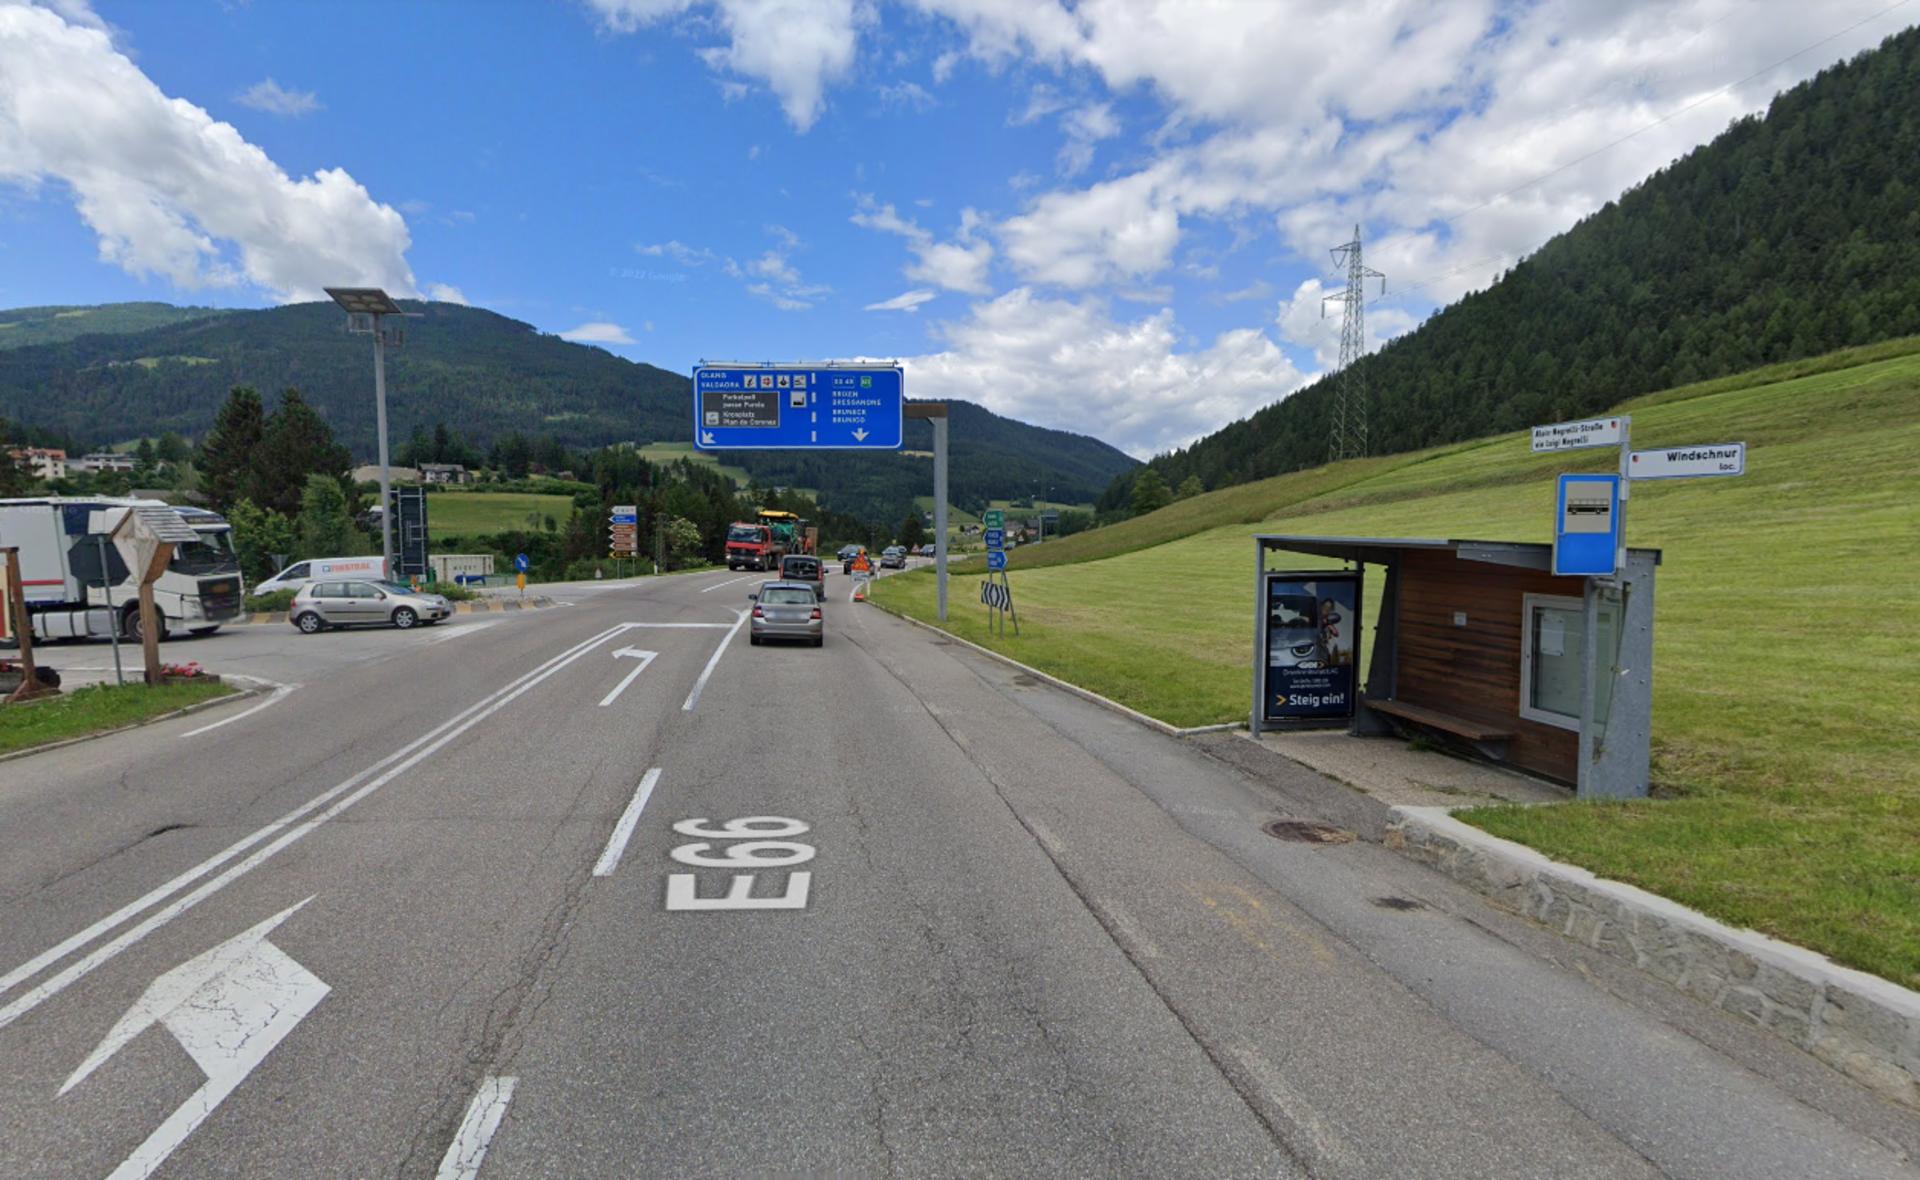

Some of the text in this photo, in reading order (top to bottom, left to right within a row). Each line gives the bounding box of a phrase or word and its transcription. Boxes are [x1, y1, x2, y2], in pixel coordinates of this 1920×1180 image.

[1667, 449, 1738, 462] Windschnur
[1289, 693, 1345, 708] Steig ein!
[666, 815, 817, 911] E66
